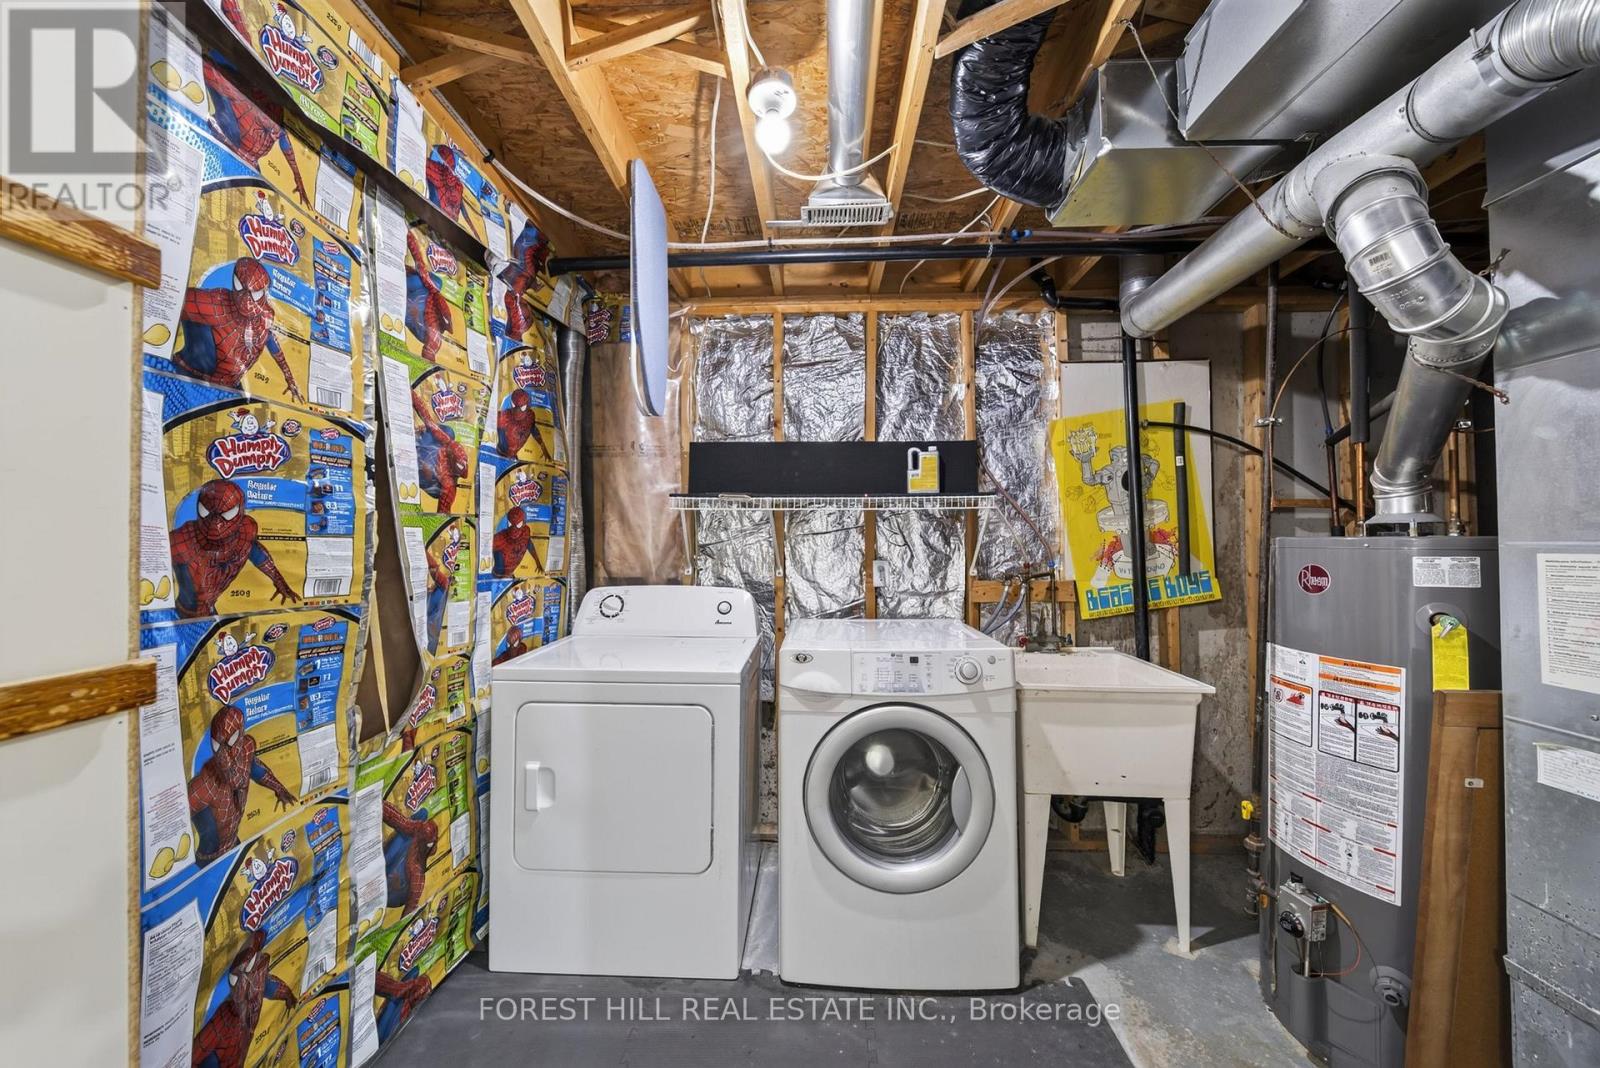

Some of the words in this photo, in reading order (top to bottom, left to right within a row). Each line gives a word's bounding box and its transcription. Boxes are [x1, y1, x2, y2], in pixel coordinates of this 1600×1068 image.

[264, 44, 318, 94] Dumpty
[267, 26, 320, 72] Humpty
[247, 216, 294, 248] Humpty
[217, 434, 285, 456] Humpty
[213, 453, 283, 479] Dumpty
[1301, 564, 1329, 588] Rheem
[211, 646, 267, 684] Humpty
[214, 662, 268, 704] Dumpty
[244, 860, 292, 913] Humpty
[244, 872, 294, 931] Dumpty
